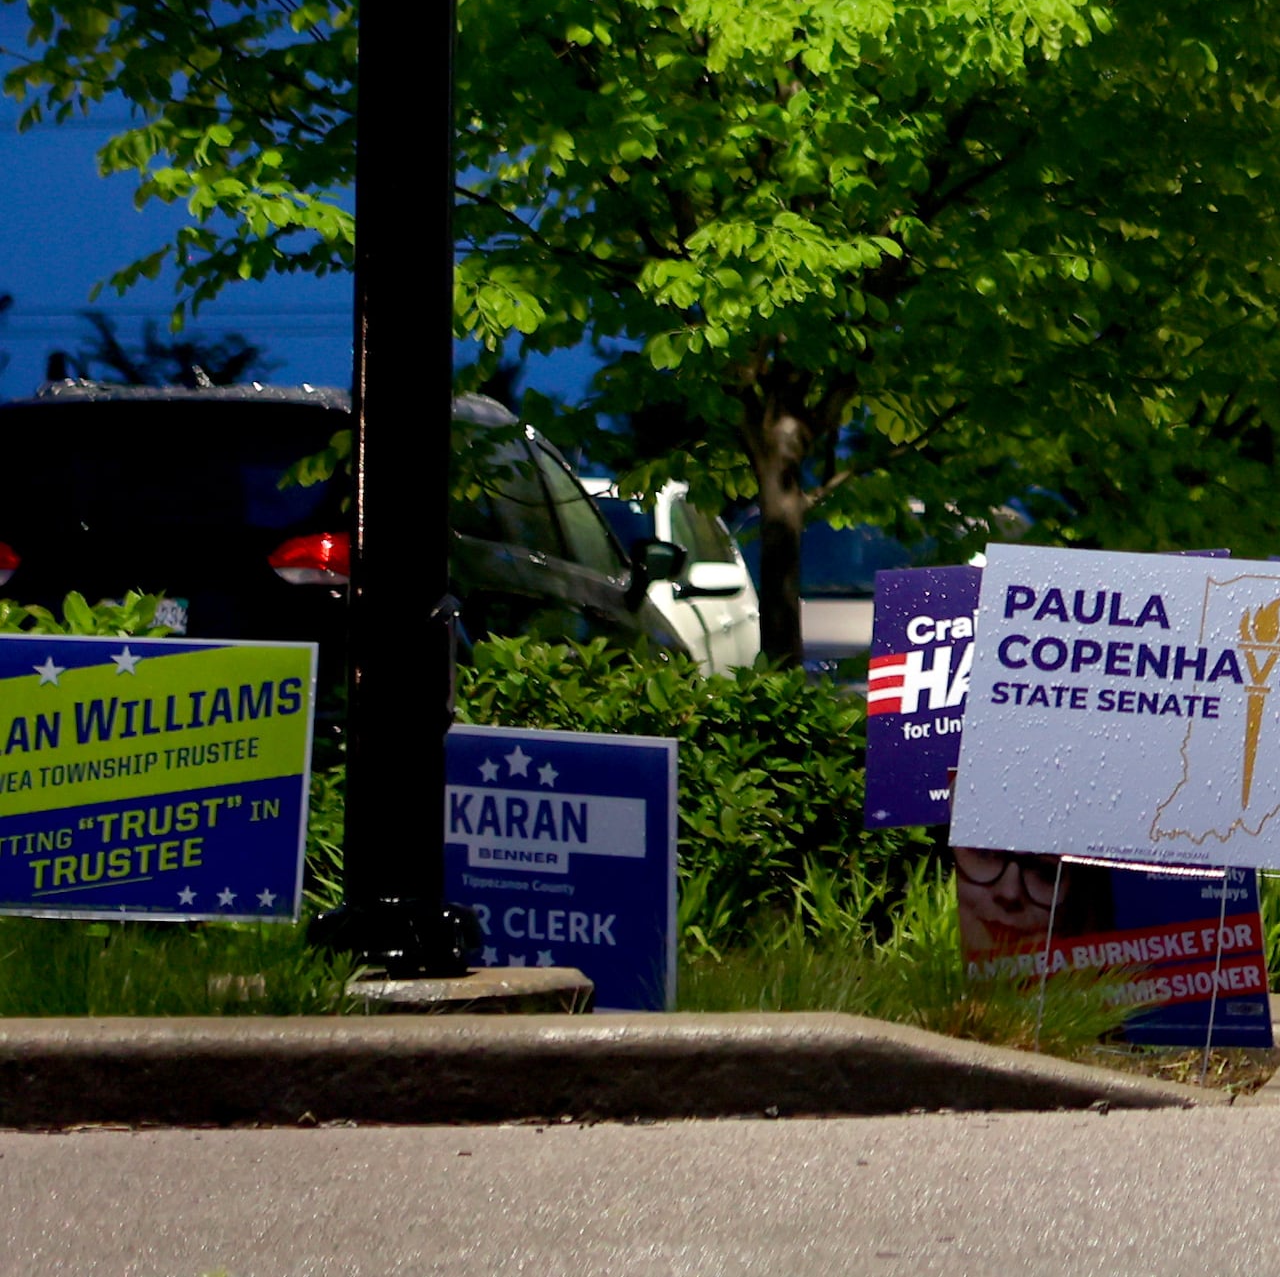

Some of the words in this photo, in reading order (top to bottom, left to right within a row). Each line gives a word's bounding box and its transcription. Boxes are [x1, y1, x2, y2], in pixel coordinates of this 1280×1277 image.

[1004, 585, 1171, 629] PAULA
[0, 712, 60, 755] AN
[74, 677, 303, 745] WILLIAMS
[991, 681, 1088, 711] STATE
[1097, 689, 1221, 720] SENATE
[901, 722, 931, 741] for
[39, 751, 158, 789] TOWNSHIP
[163, 736, 260, 771] TRUSTEE
[249, 798, 280, 822] IN
[450, 792, 588, 844] KARAN
[28, 837, 204, 890] TRUSTEE
[478, 847, 559, 864] BENNER
[462, 873, 529, 890] Tippecanoe
[532, 879, 575, 896] County
[503, 906, 617, 946] CLERK
[1072, 930, 1198, 971] BURNISKE
[1201, 923, 1254, 952] FOR
